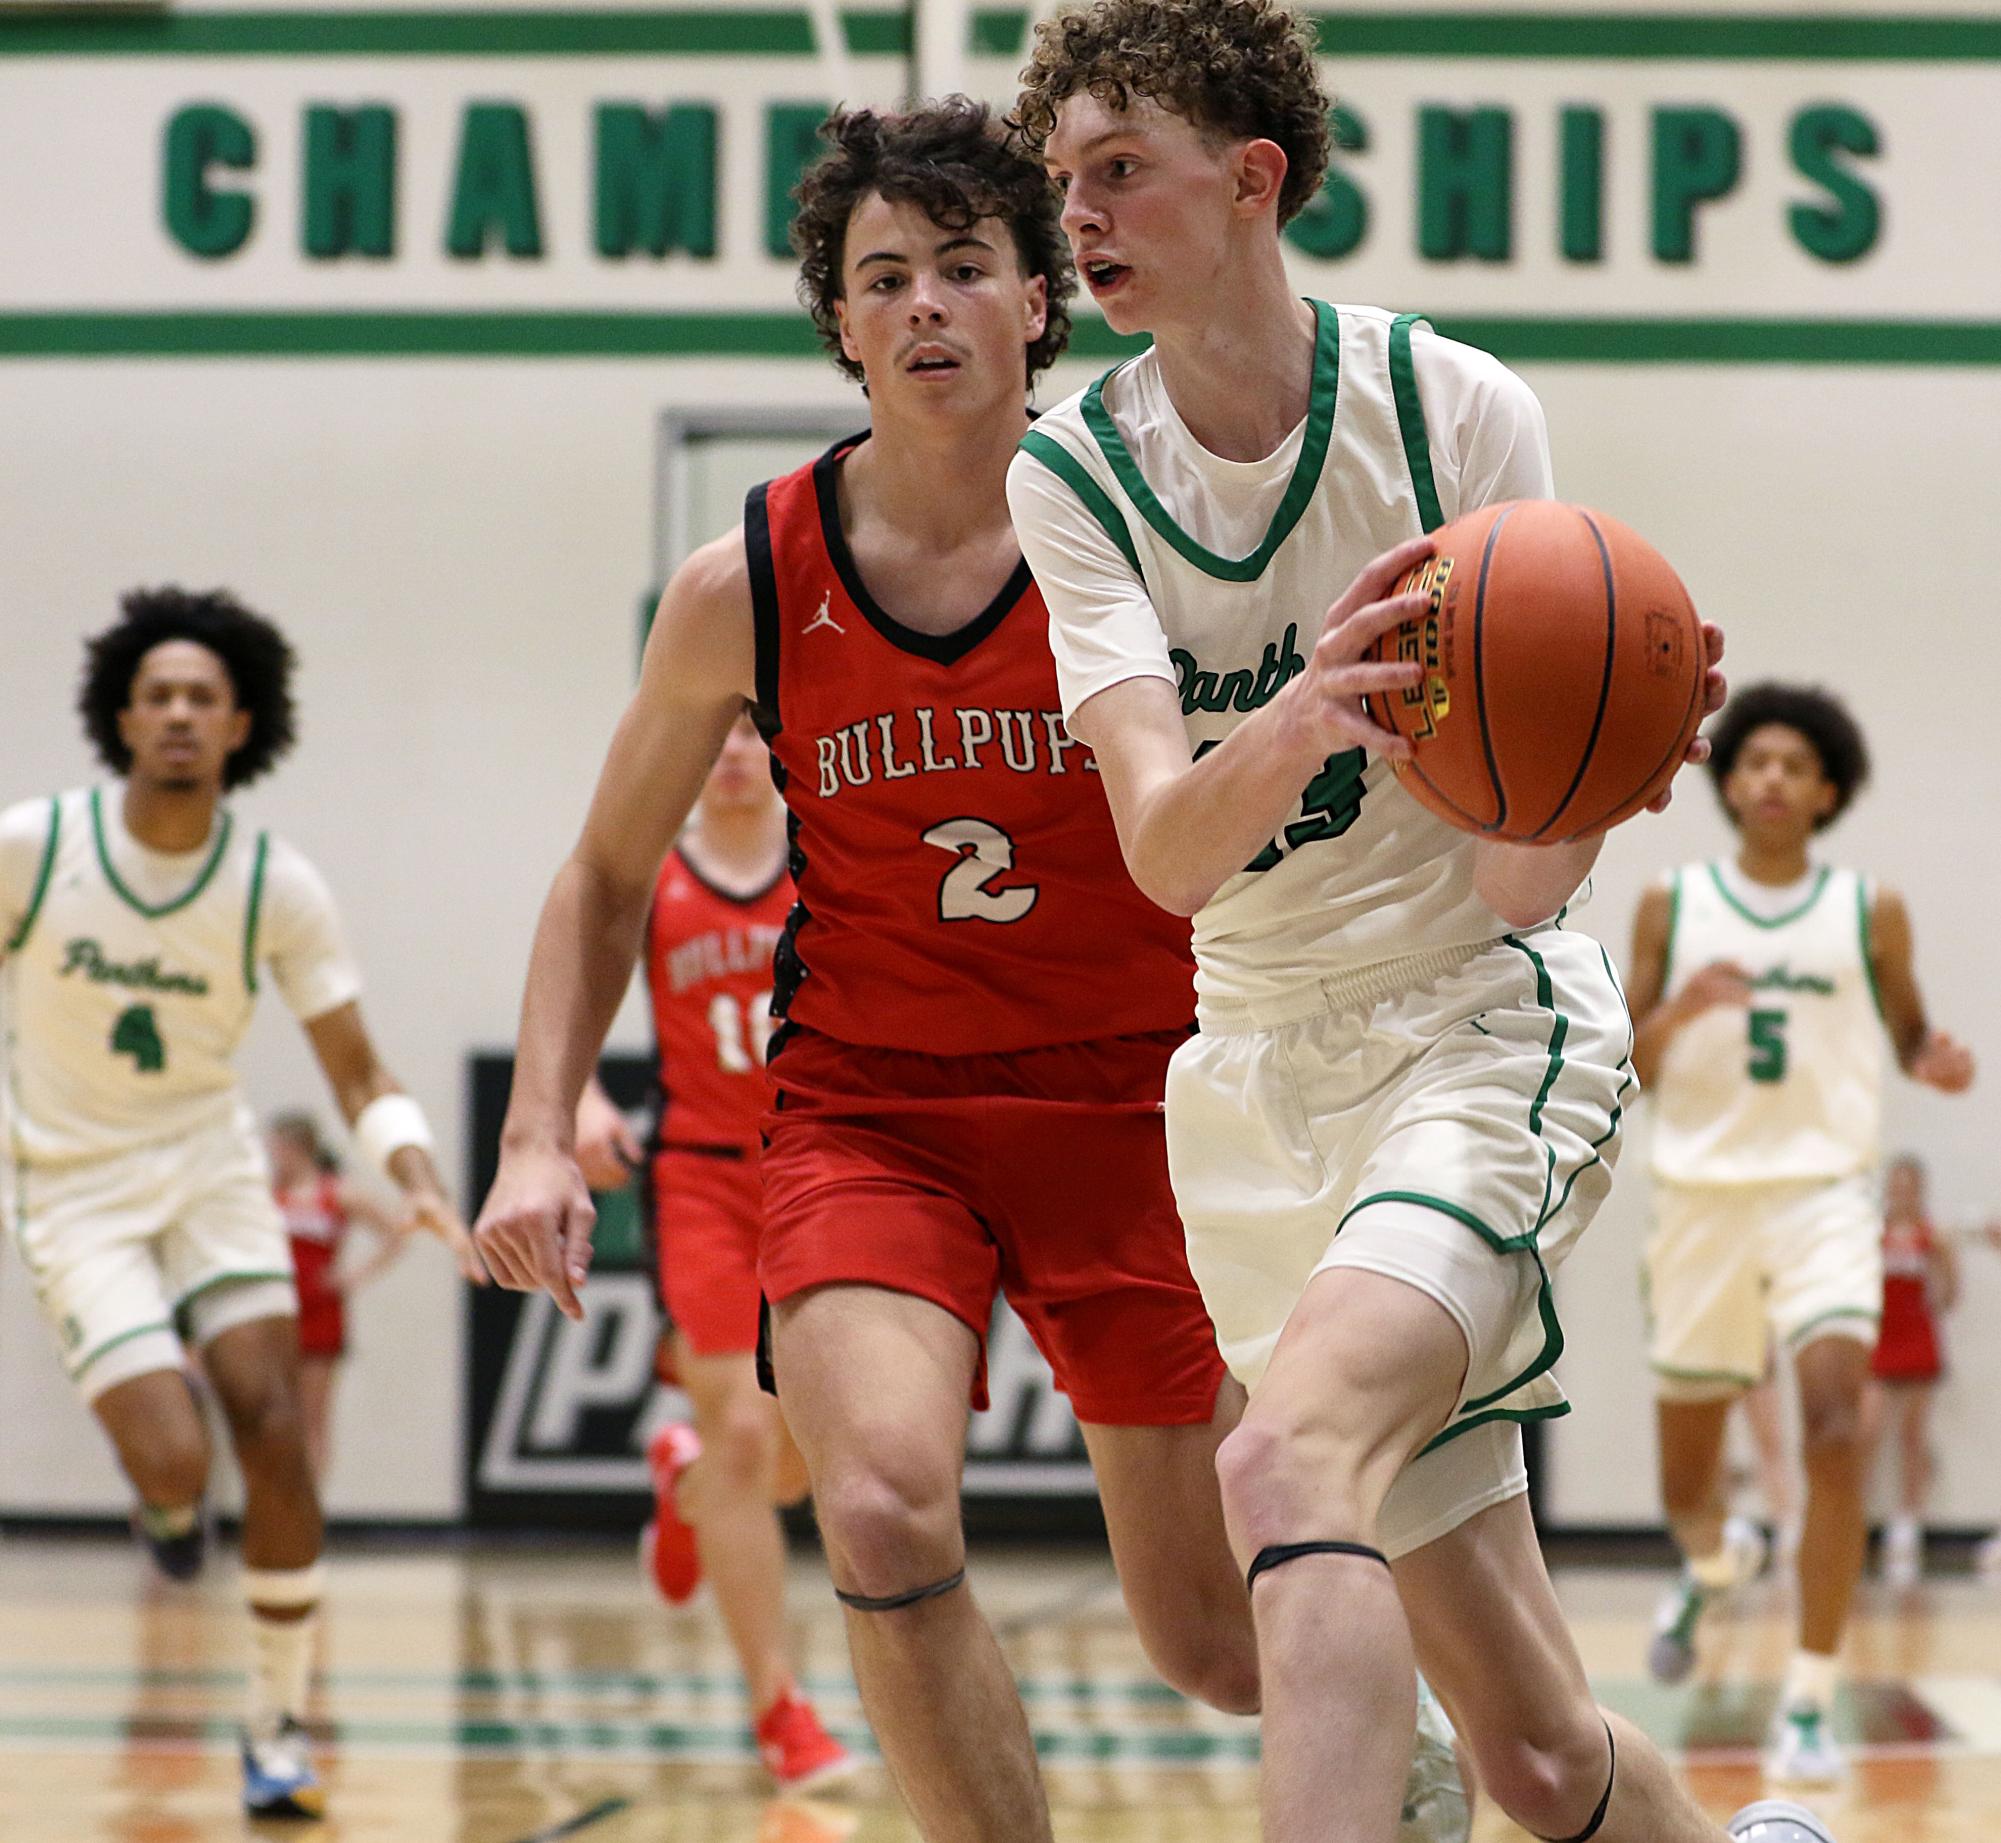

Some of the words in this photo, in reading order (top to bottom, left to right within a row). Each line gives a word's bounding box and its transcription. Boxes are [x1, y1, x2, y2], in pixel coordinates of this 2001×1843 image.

[1168, 622, 1306, 716] Panth
[816, 707, 1100, 798] BULLPUP
[920, 815, 1040, 924] 2
[110, 1007, 167, 1073] 4
[1746, 1009, 1789, 1084] 5
